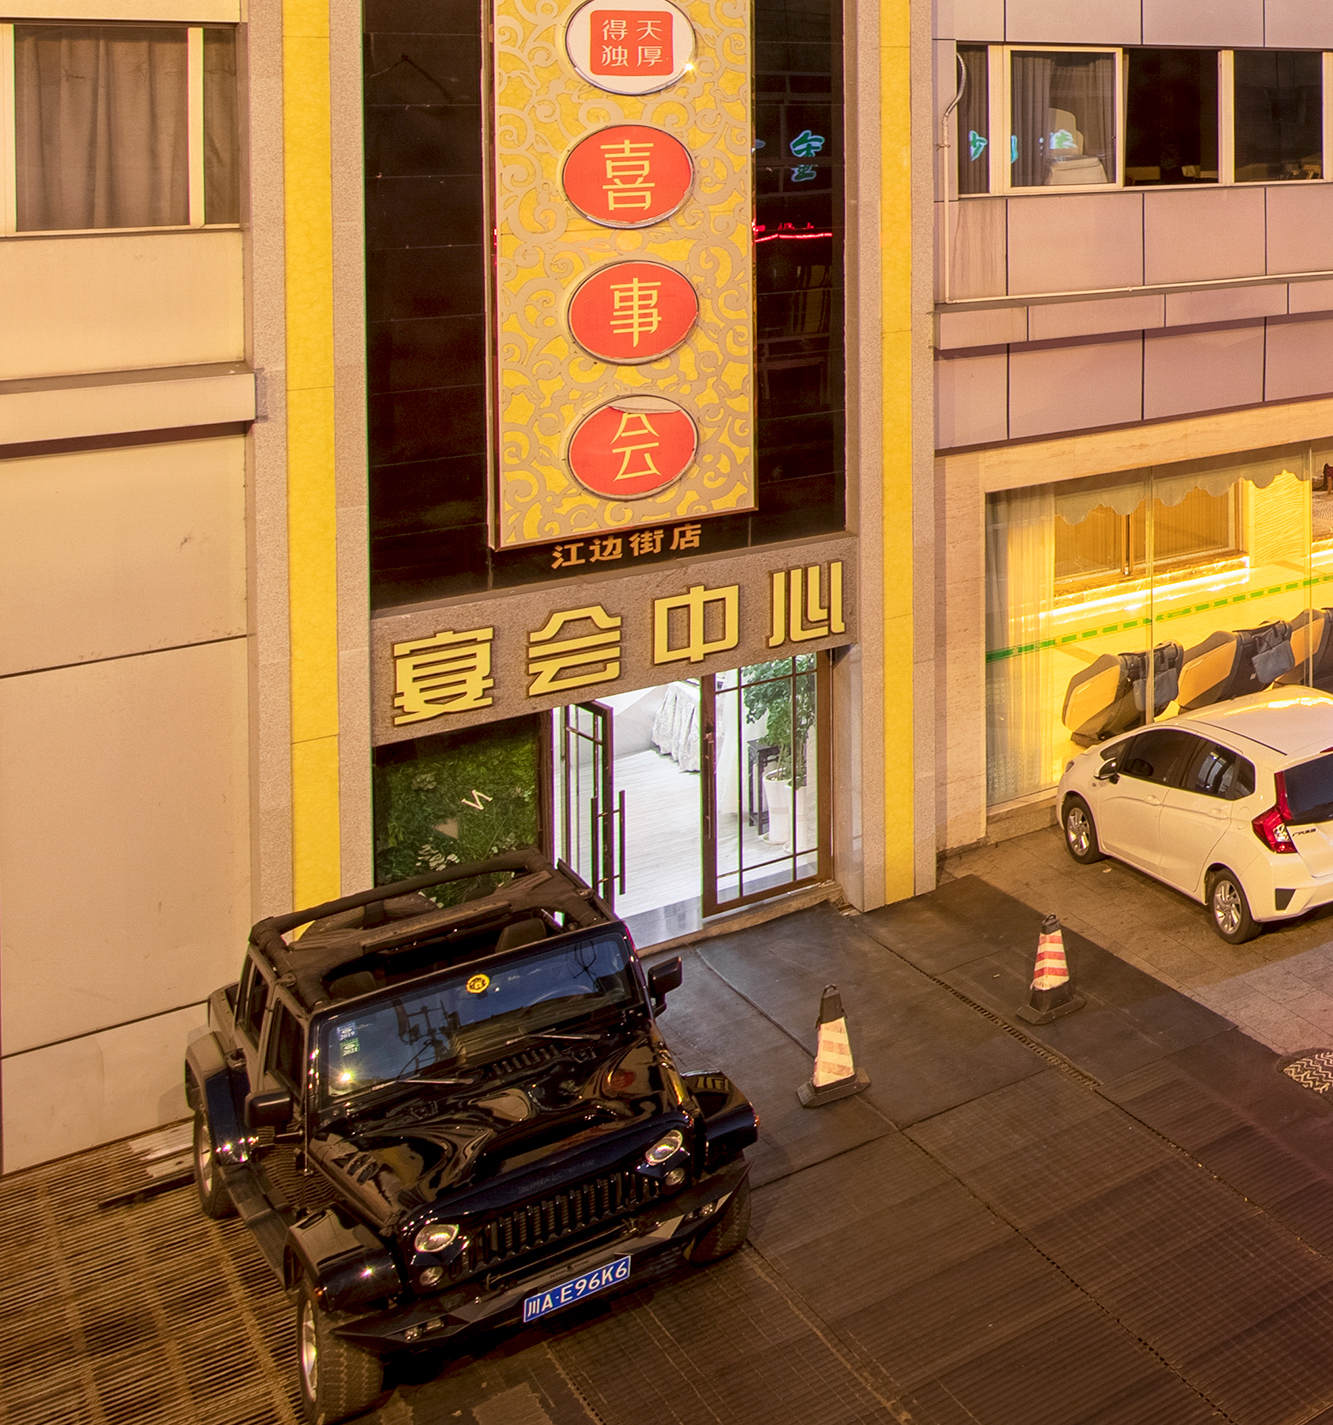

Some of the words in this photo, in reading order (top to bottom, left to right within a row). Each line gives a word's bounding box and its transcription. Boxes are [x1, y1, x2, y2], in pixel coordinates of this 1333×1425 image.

[550, 523, 702, 570] 江边街店
[393, 562, 846, 726] 宴会中心
